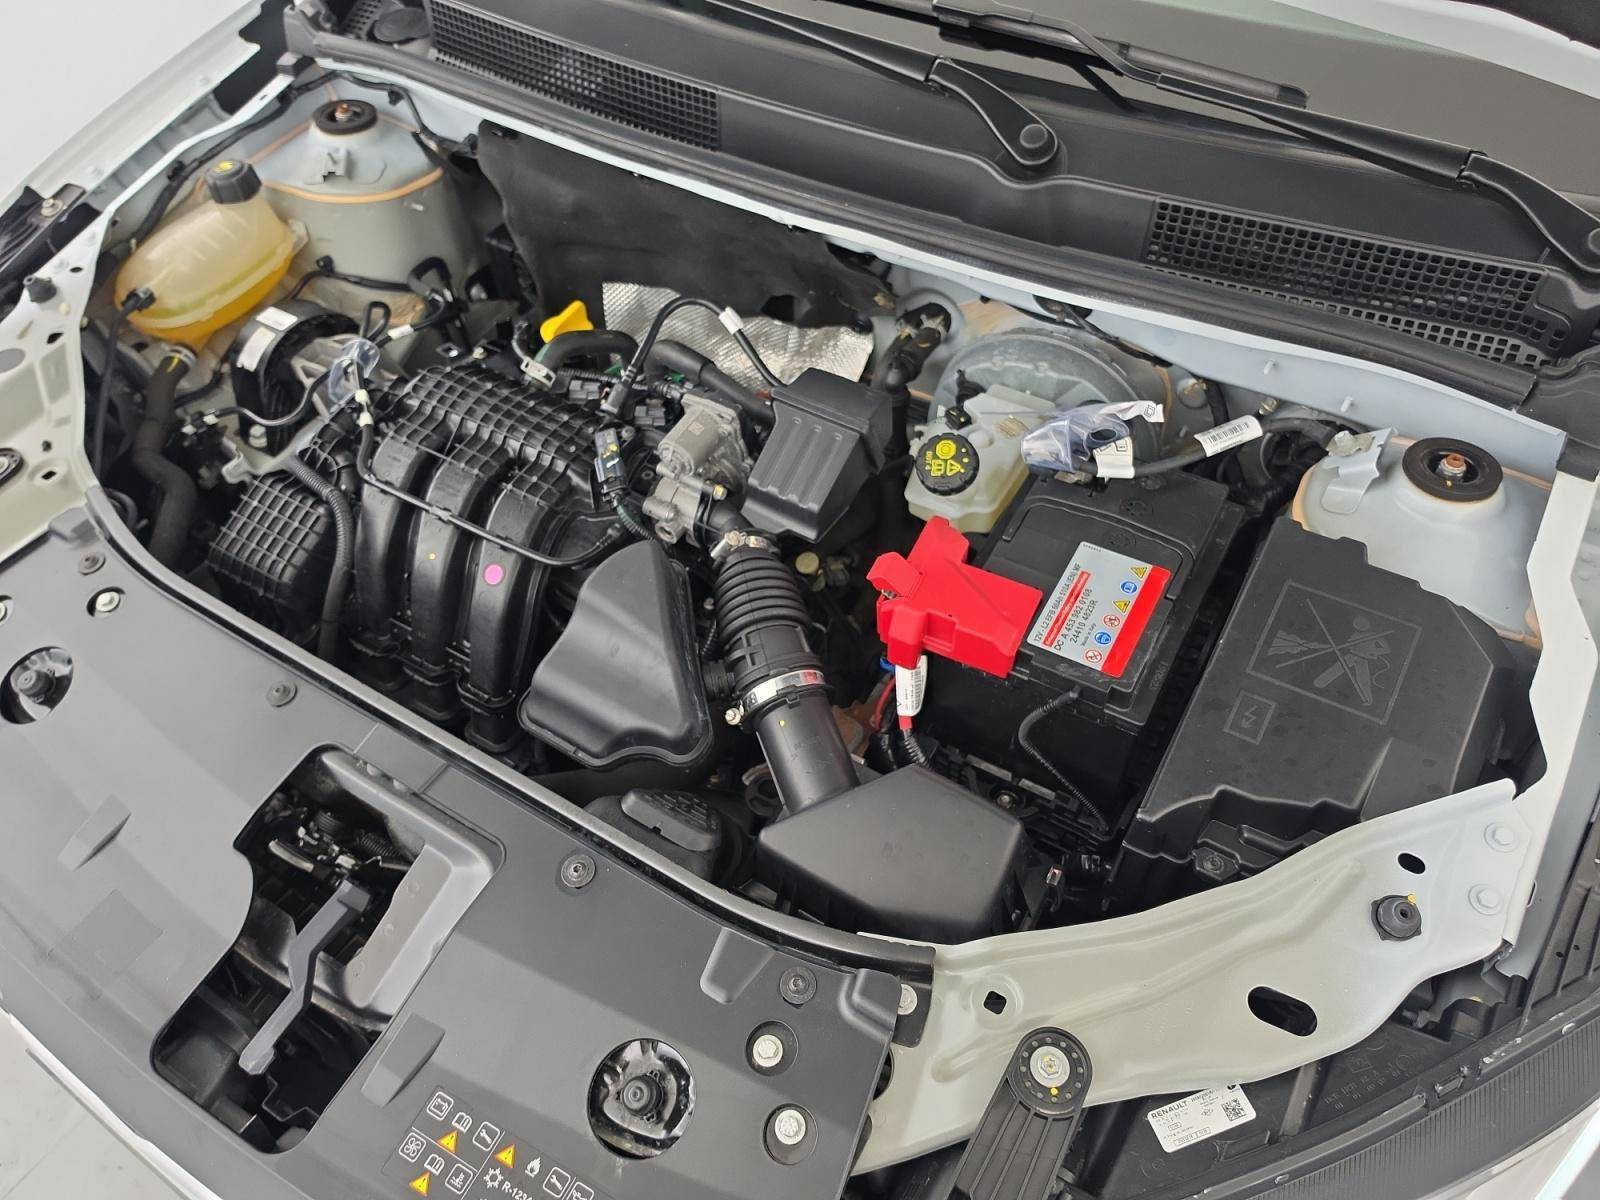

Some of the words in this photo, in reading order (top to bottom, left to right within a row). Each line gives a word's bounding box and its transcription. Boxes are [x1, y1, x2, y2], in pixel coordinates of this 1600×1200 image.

[1054, 640, 1063, 651] DC
[1064, 618, 1075, 632] 453
[1072, 605, 1082, 618] 982
[1079, 587, 1092, 605] 0108
[1069, 621, 1085, 643] 24410
[1082, 598, 1098, 621] 4823R
[1151, 1100, 1188, 1118] RENAULT
